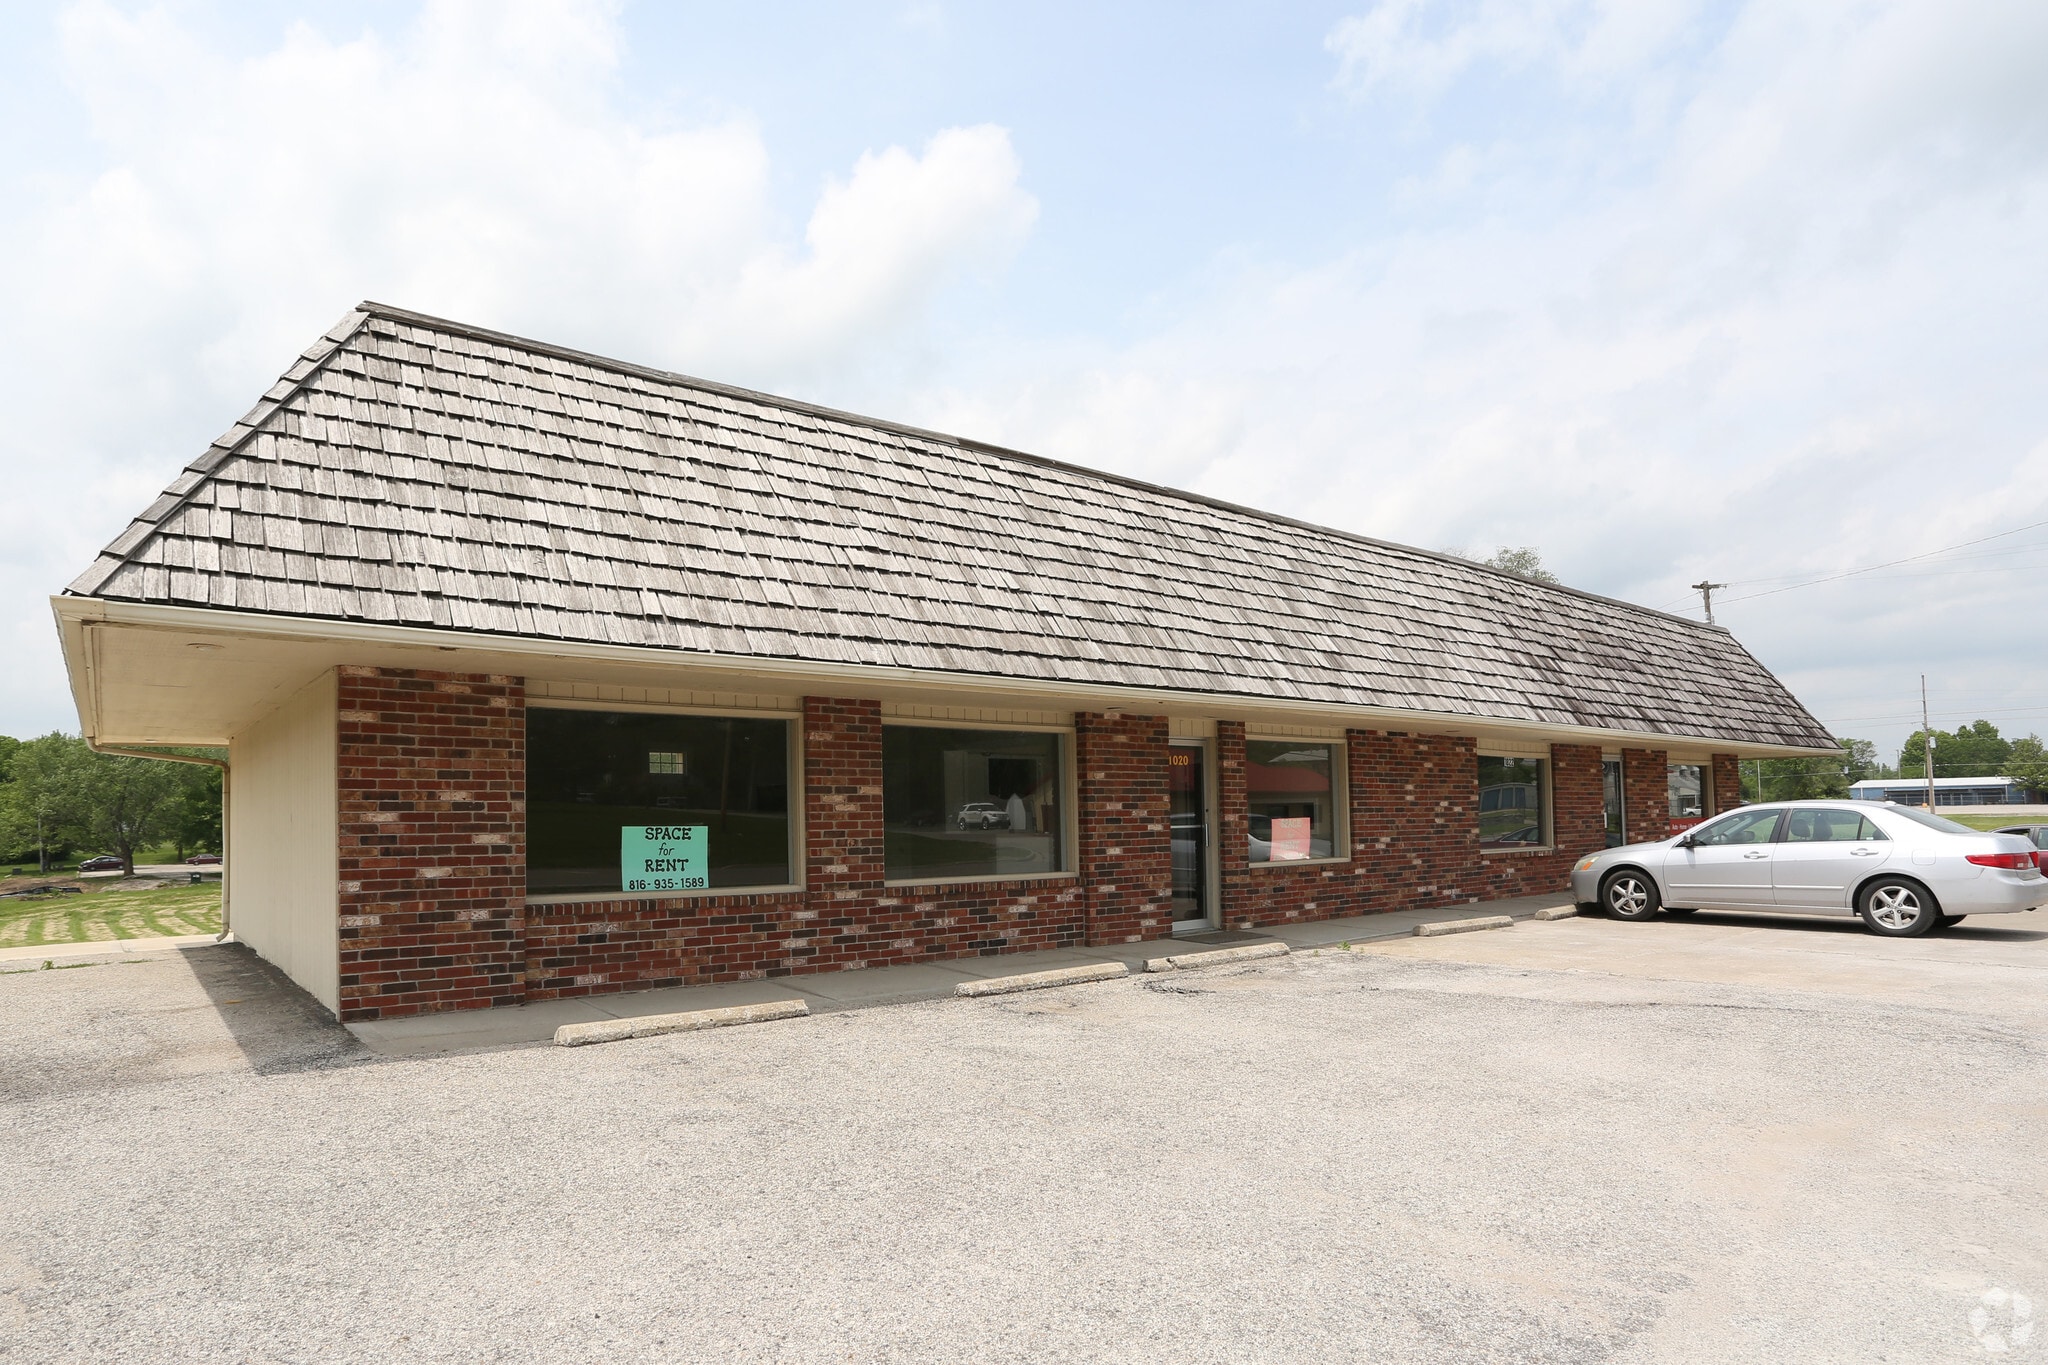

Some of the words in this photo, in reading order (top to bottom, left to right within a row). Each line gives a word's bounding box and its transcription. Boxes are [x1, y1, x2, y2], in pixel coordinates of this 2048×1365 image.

[1168, 755, 1189, 766] 1020
[645, 827, 692, 841] SPACE
[658, 842, 675, 856] for
[645, 858, 689, 872] RENT
